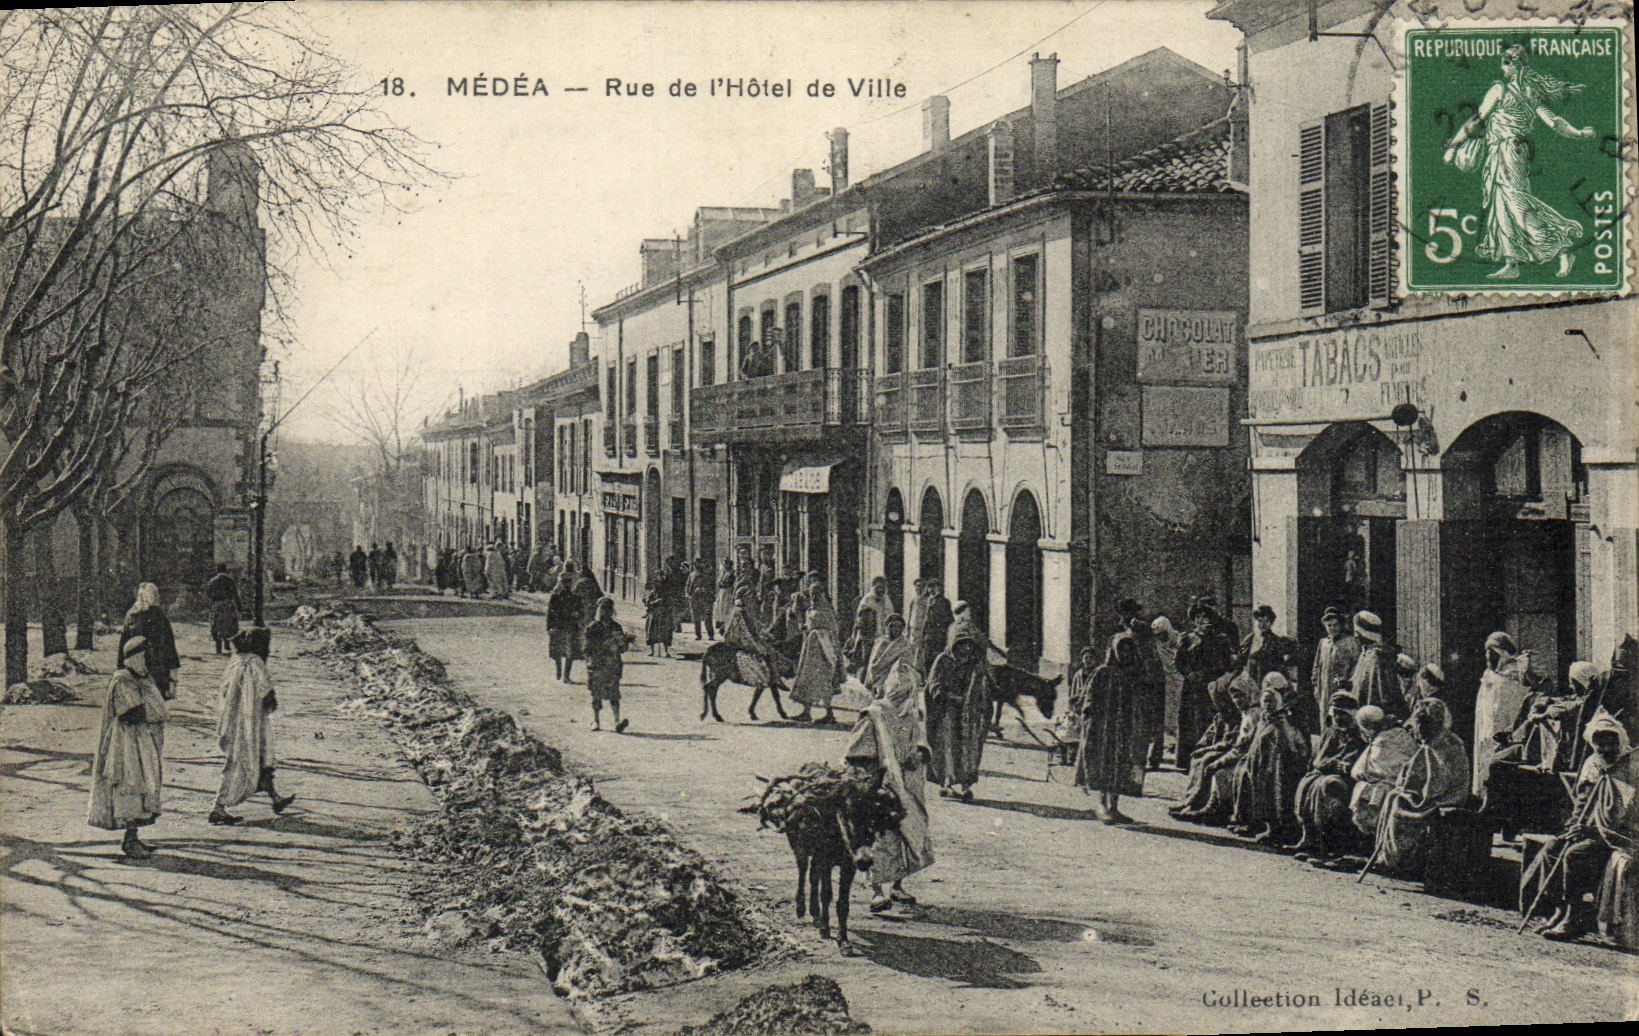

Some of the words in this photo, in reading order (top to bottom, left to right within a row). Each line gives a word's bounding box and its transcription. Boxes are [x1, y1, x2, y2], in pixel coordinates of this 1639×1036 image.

[1530, 37, 1613, 59] FRANÇAISE
[1593, 189, 1614, 275] POSTES
[1298, 333, 1382, 388] TABACS
